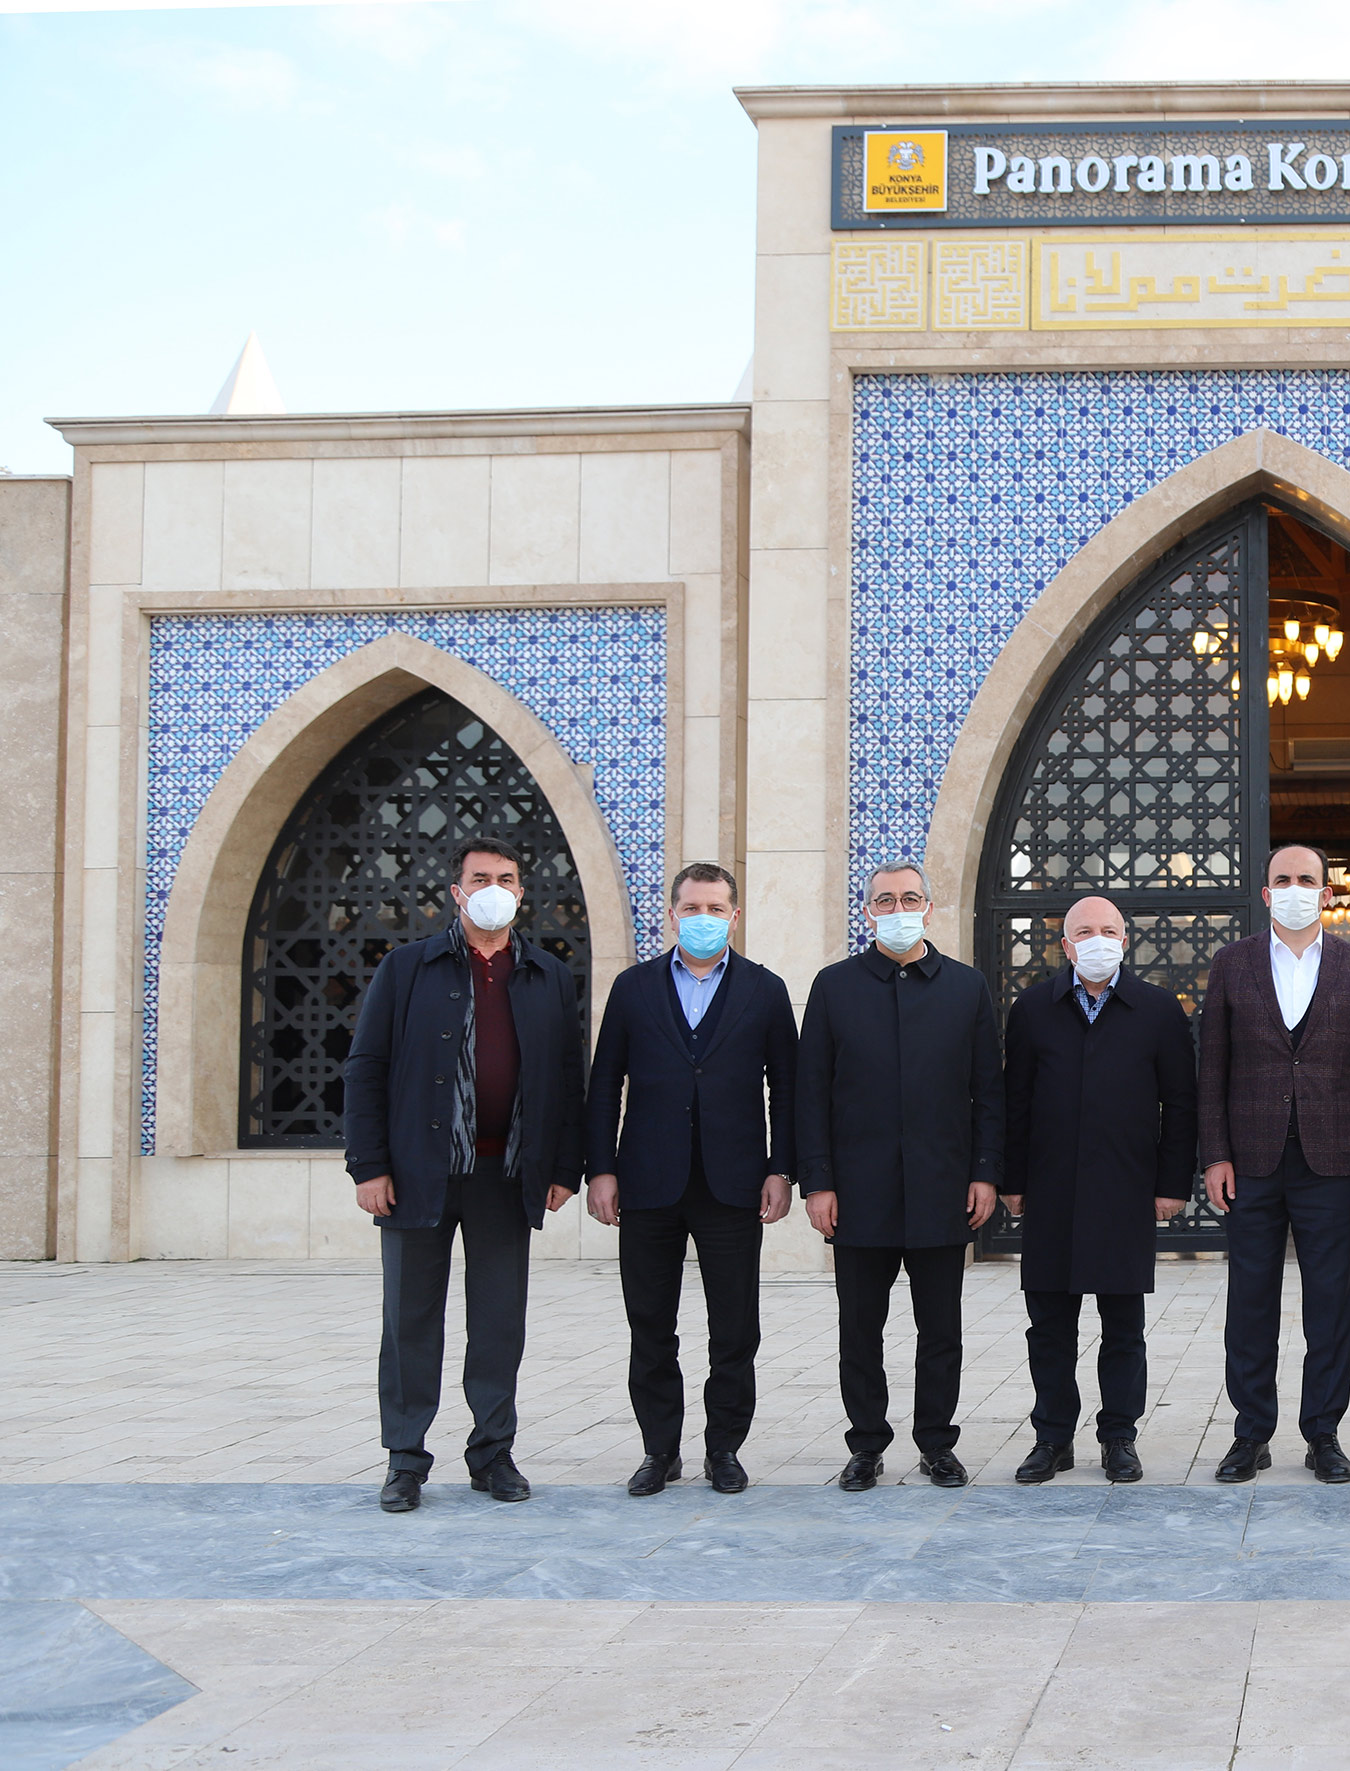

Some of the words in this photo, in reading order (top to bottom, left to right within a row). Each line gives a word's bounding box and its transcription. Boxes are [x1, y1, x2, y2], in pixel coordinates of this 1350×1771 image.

[973, 146, 1255, 195] Panorama
[889, 175, 922, 183] KONYA
[872, 184, 939, 195] BÜYÜKŞEHİR
